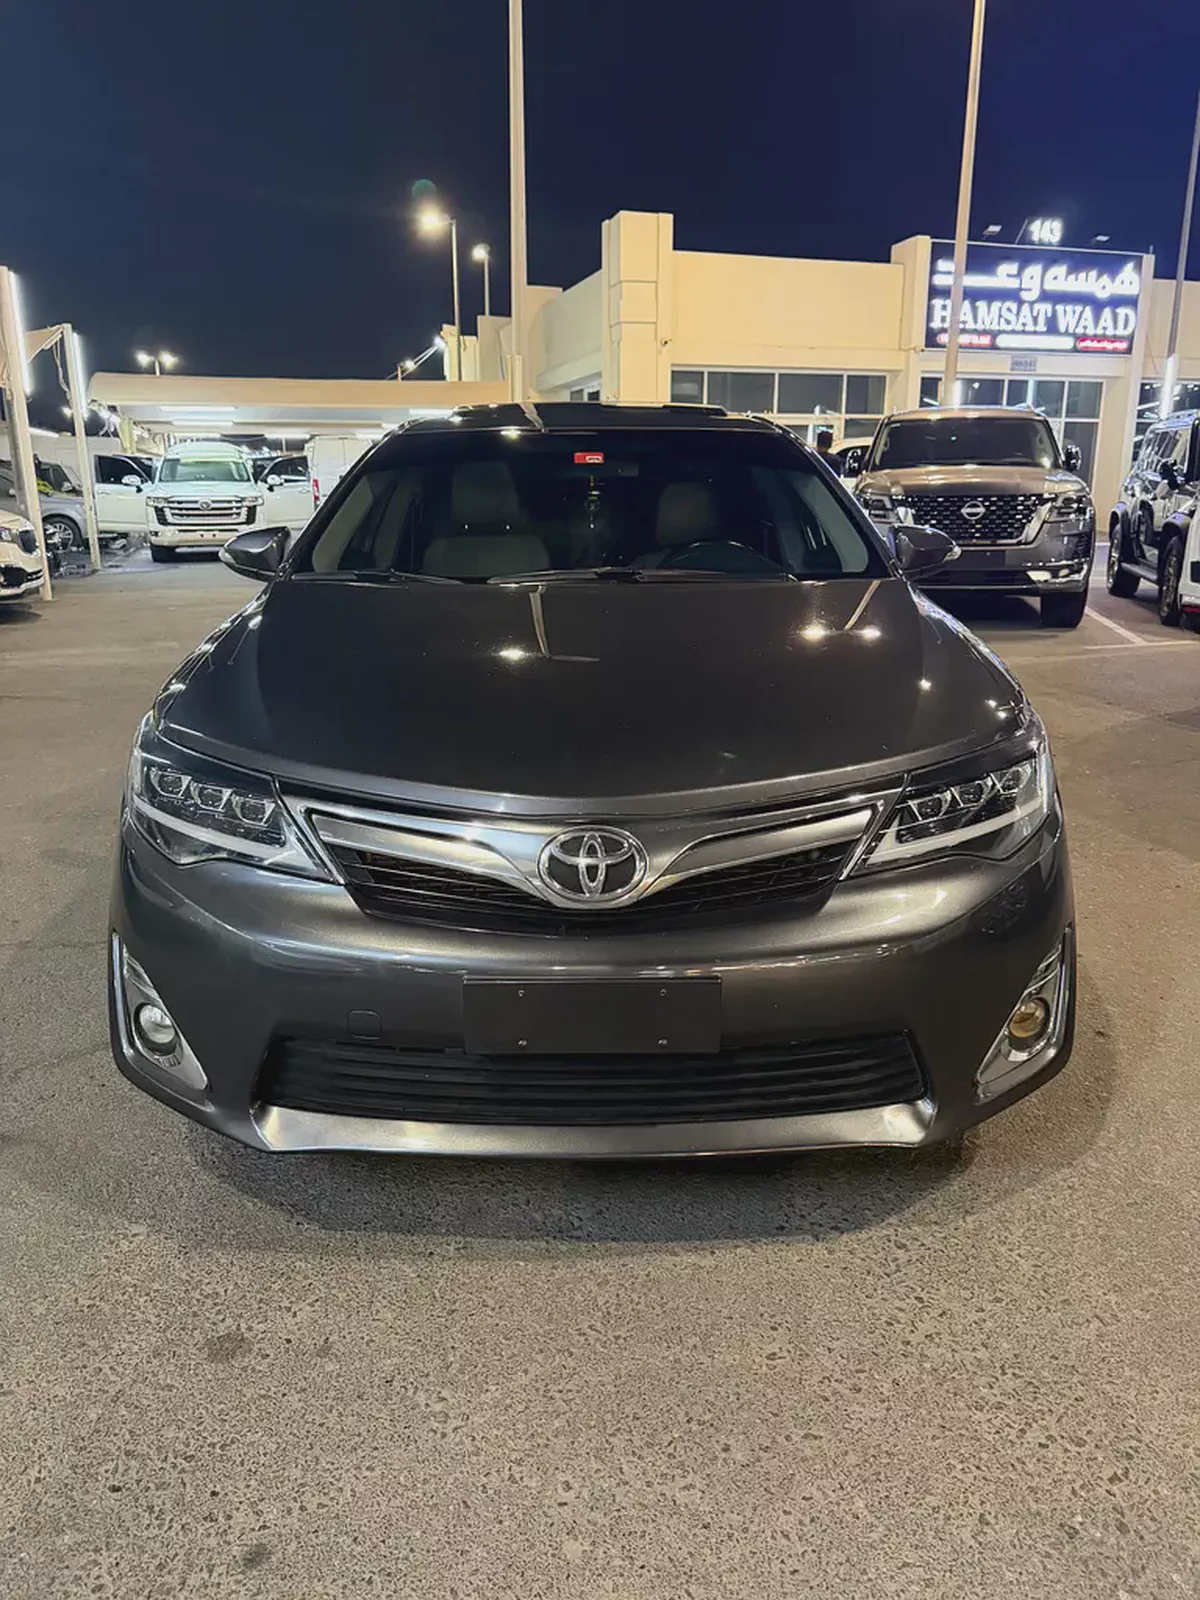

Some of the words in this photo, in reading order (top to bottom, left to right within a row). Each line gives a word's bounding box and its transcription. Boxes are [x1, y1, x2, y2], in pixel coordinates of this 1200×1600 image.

[1029, 218, 1062, 243] 143
[930, 299, 1051, 331] HAMSAT
[1055, 303, 1136, 336] WAAD
